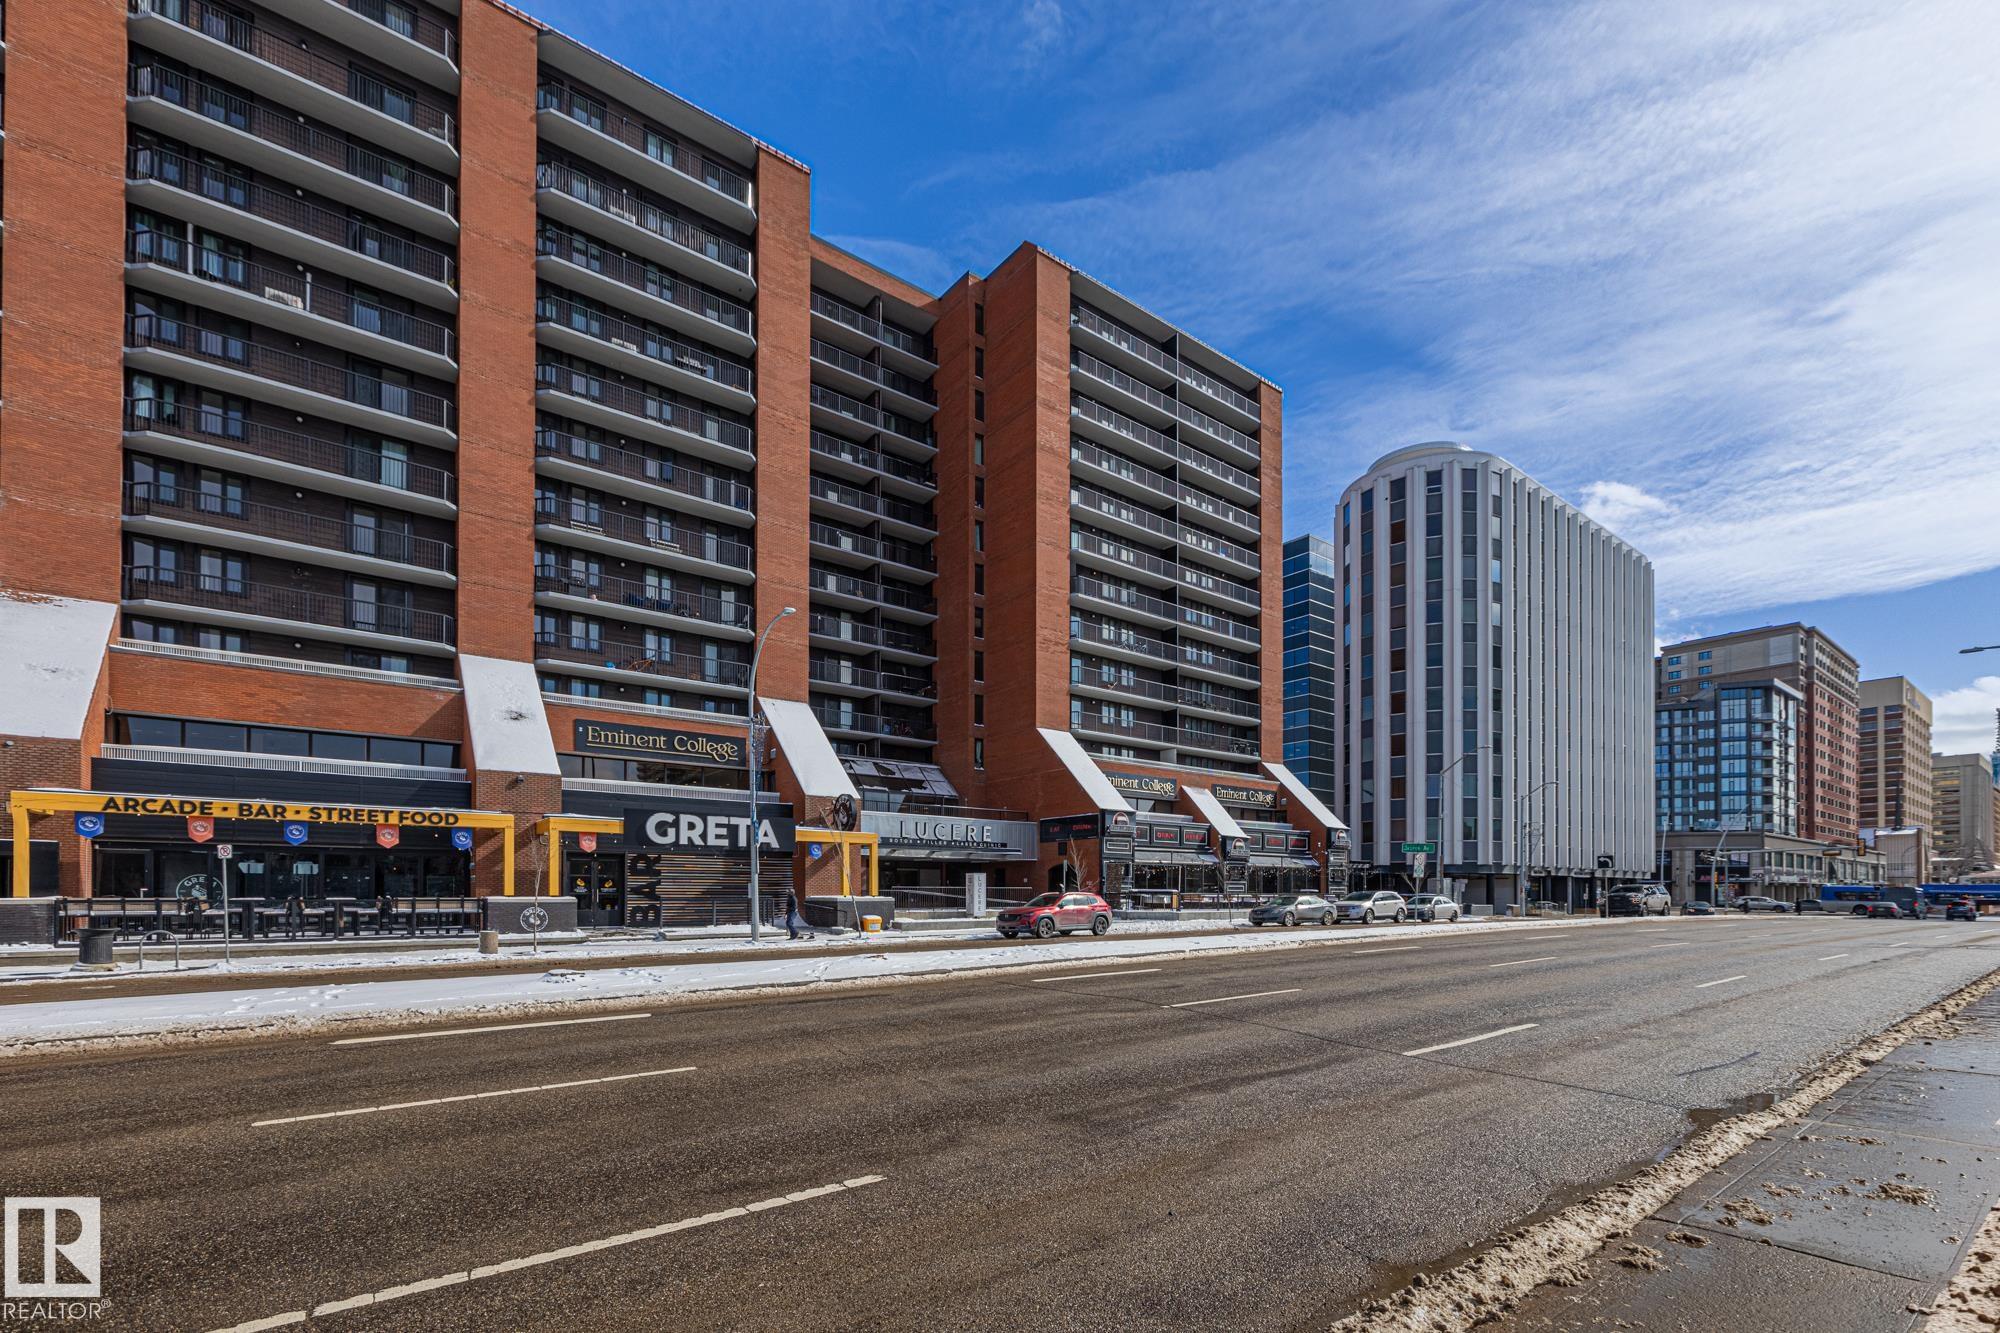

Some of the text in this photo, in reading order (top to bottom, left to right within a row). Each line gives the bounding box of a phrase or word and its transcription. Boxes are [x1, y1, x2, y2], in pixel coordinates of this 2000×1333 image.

[587, 726, 738, 762] Eminent College
[1108, 775, 1175, 796] minent College
[1216, 786, 1275, 807] Eminent College
[102, 796, 459, 826] ARCADE BAR STREET FOOD
[645, 812, 780, 848] GRETA
[900, 820, 992, 842] LUCERE
[628, 852, 661, 927] BAR
